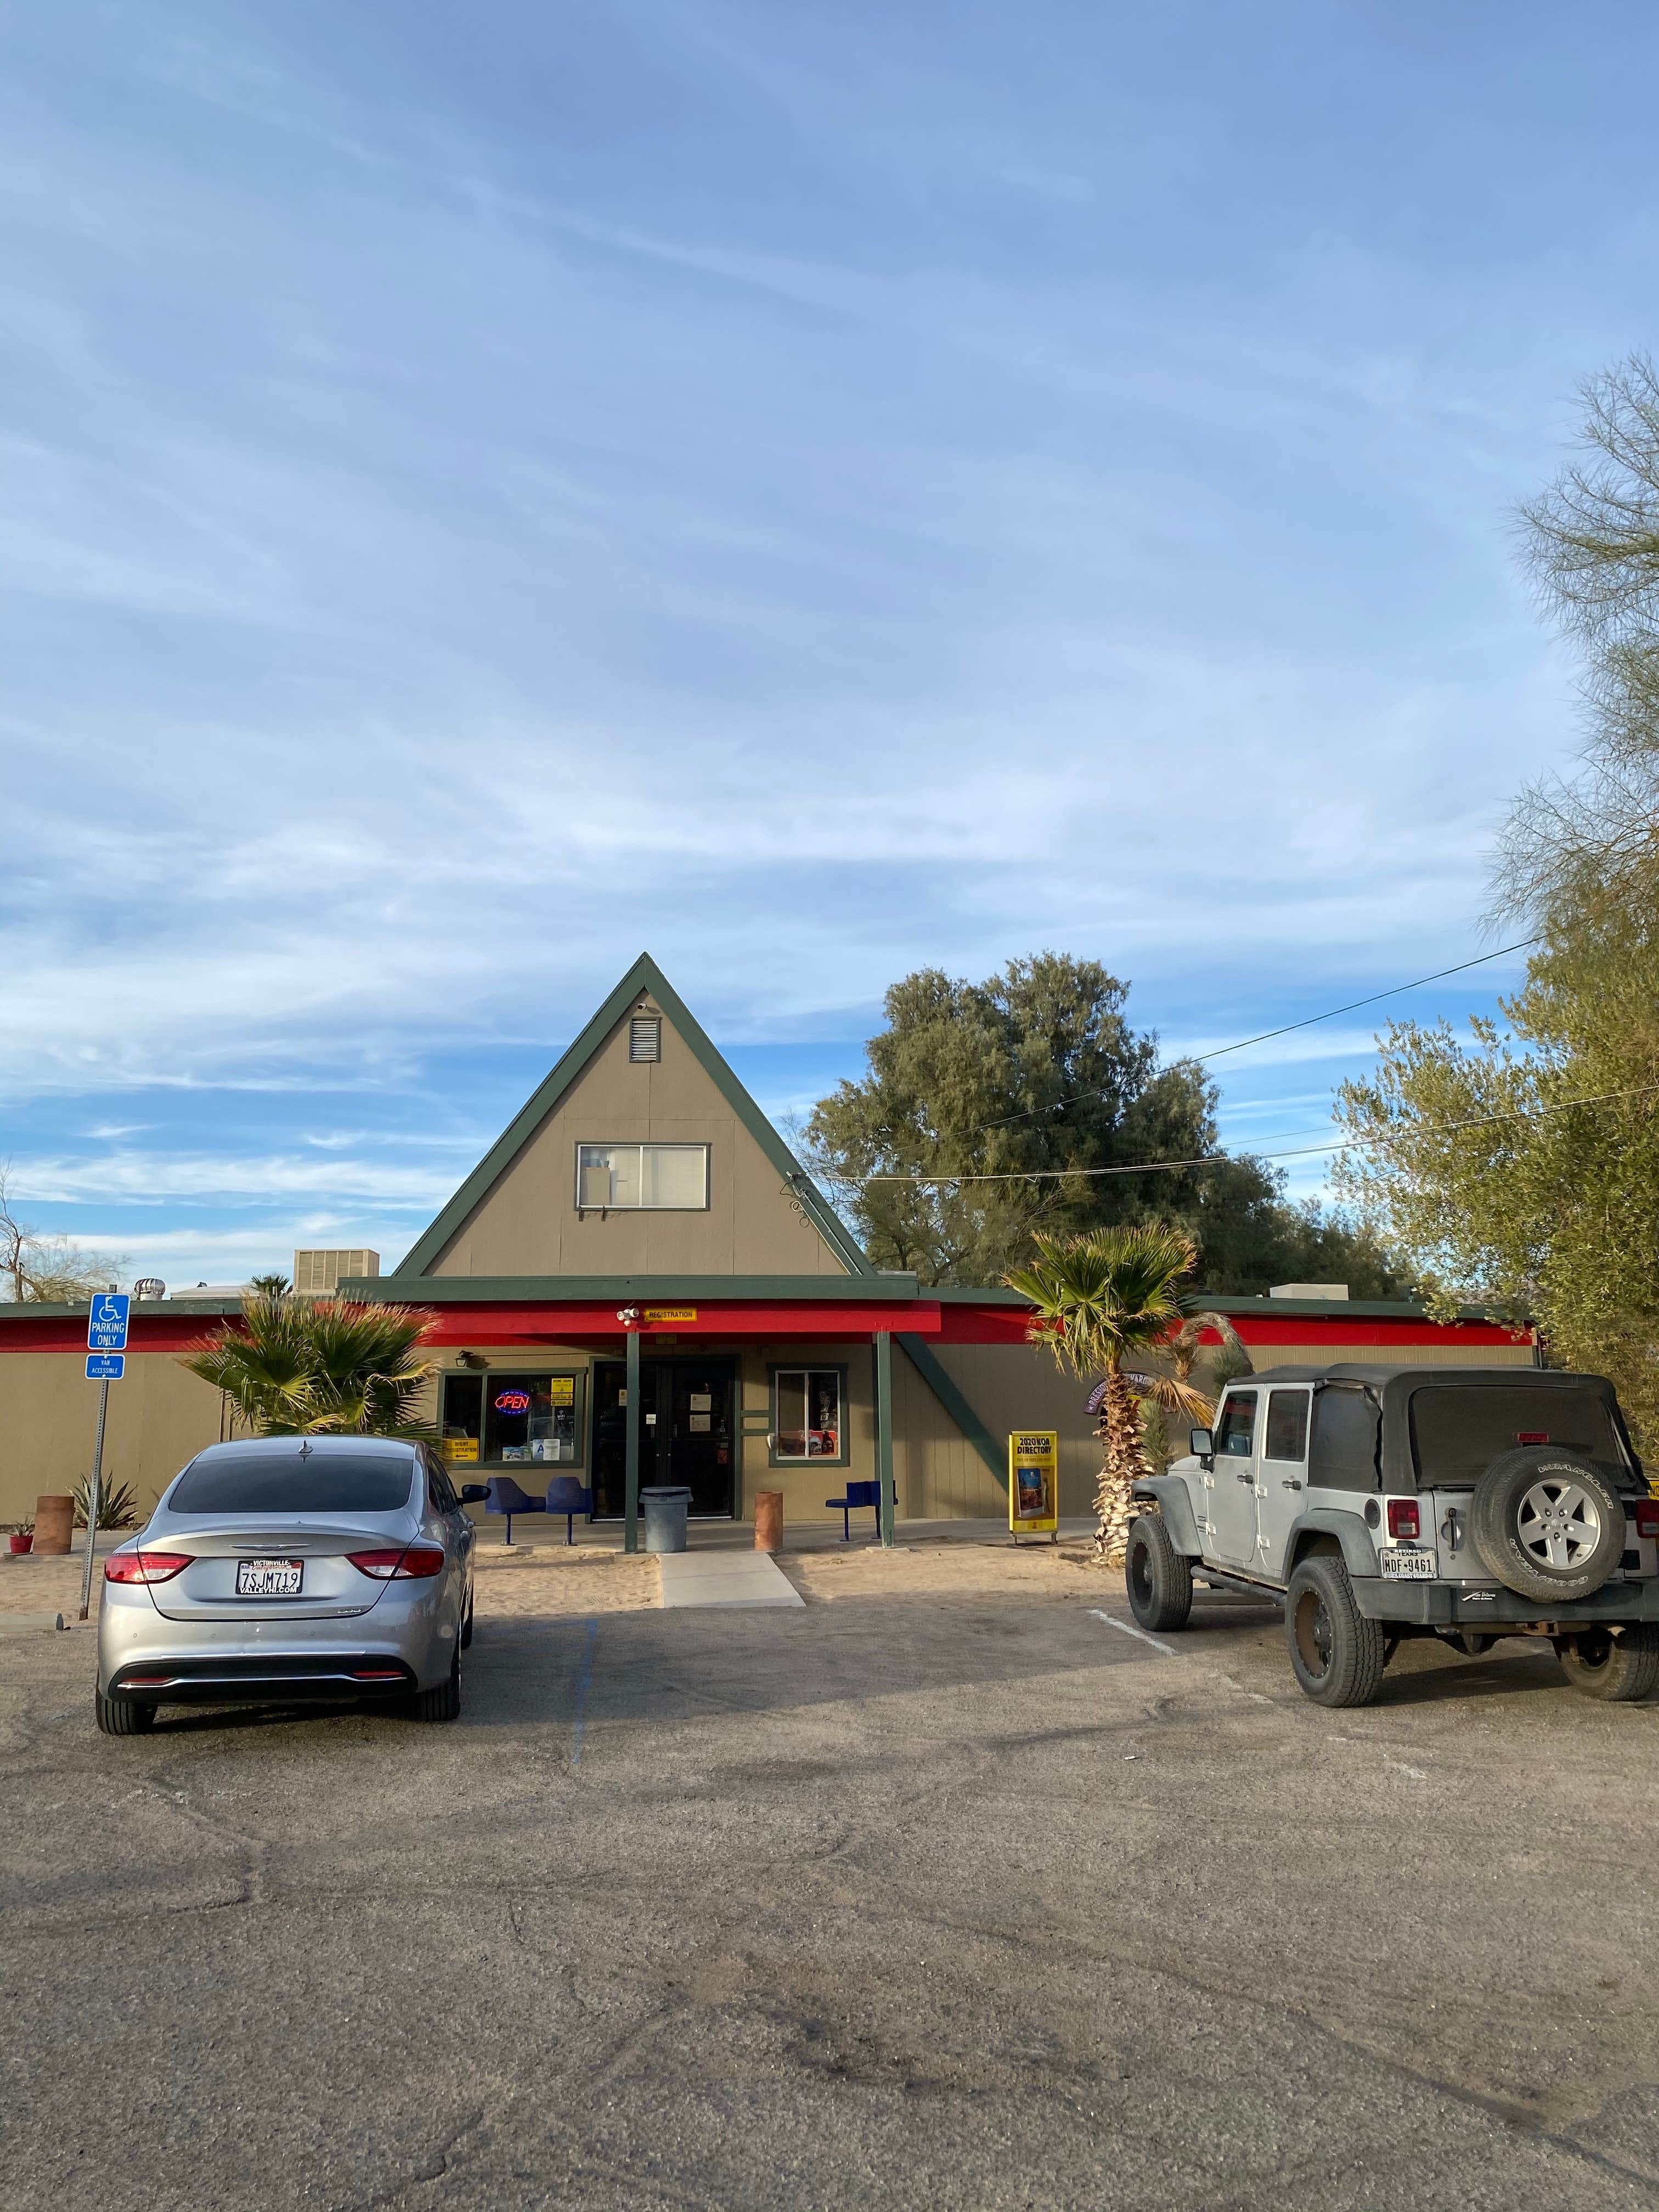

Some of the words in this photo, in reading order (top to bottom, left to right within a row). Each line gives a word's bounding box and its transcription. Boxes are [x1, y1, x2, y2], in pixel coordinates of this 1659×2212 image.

[92, 1322, 125, 1333] PARKING
[97, 1335, 117, 1345] ONLY
[495, 1396, 529, 1409] OPEN
[537, 1444, 544, 1453] A
[1017, 1446, 1052, 1454] DIRECTORY
[1538, 1463, 1614, 1509] WRANGLER
[1509, 1538, 1589, 1587] GOODYEAR
[242, 1572, 298, 1588] 7SJM719
